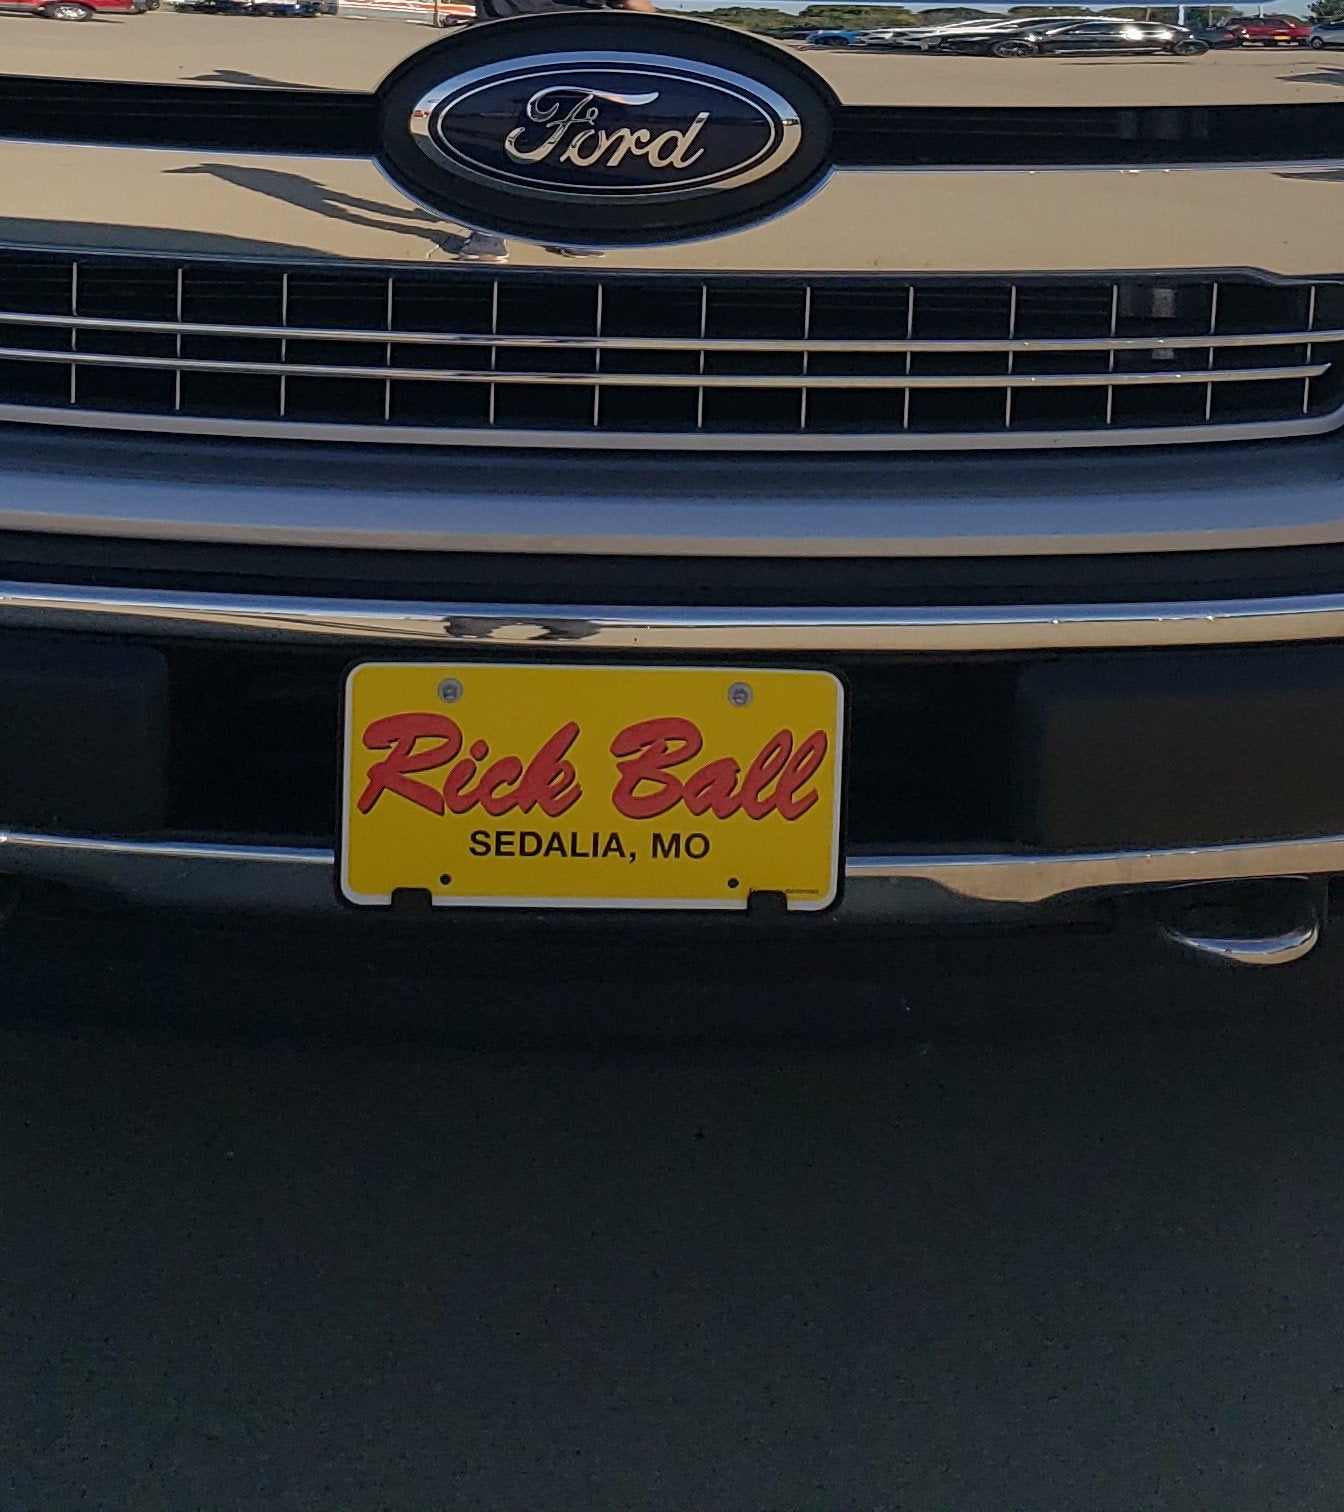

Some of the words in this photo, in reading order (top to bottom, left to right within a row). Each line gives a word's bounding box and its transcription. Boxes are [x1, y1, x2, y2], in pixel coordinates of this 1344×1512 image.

[504, 85, 710, 168] Ford
[356, 711, 583, 817] Rick
[609, 716, 828, 821] Ball
[468, 830, 638, 864] SEDALIA,
[651, 832, 711, 860] MO
